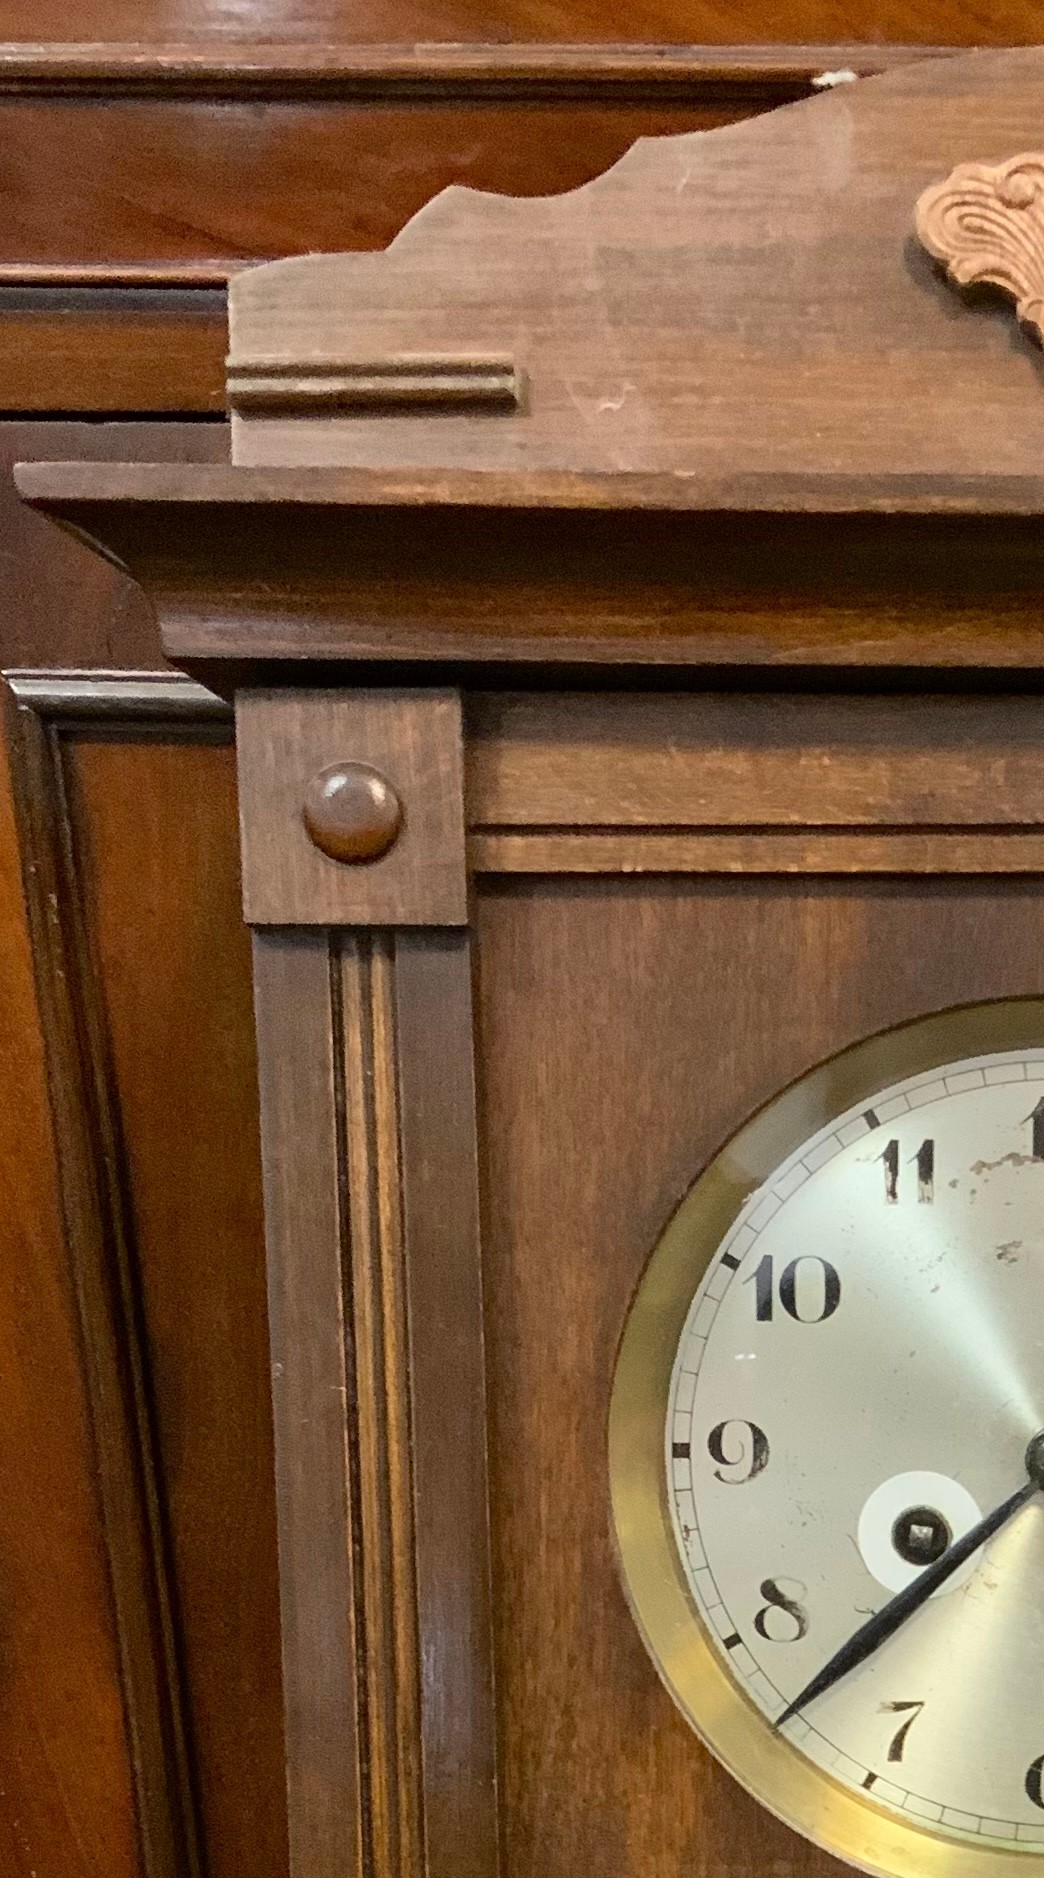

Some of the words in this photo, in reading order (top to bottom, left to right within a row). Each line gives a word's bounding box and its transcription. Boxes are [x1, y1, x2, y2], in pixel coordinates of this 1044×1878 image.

[876, 1139, 934, 1205] 11
[742, 1255, 841, 1323] 10
[706, 1419, 770, 1484] 9
[753, 1578, 810, 1643] 8
[878, 1700, 925, 1762] 7
